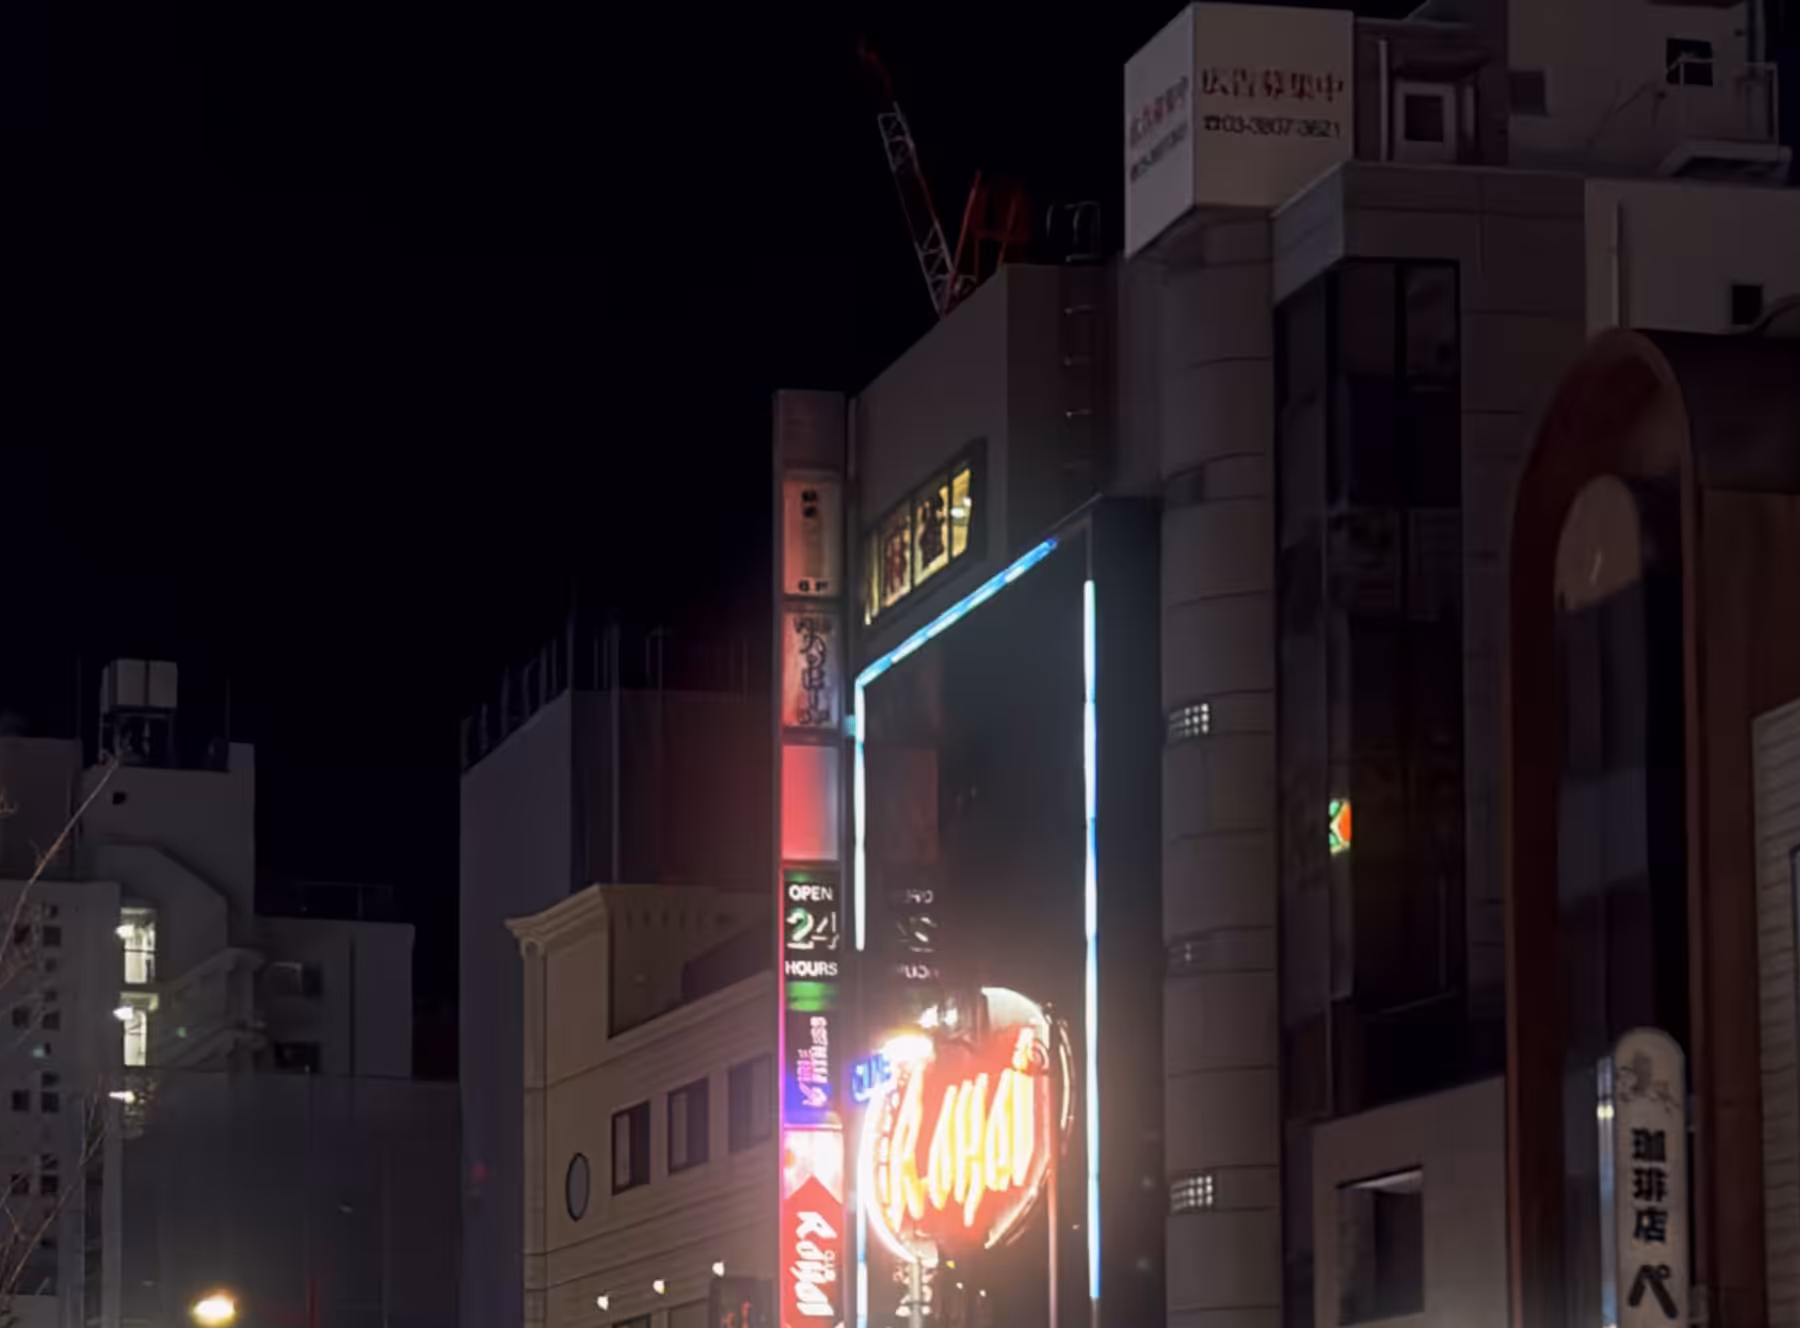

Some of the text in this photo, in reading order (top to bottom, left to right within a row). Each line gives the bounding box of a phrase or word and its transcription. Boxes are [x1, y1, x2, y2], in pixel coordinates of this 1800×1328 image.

[788, 884, 834, 902] OPEN
[784, 960, 839, 977] HOURS
[1630, 1127, 1669, 1244] 珈琲店
